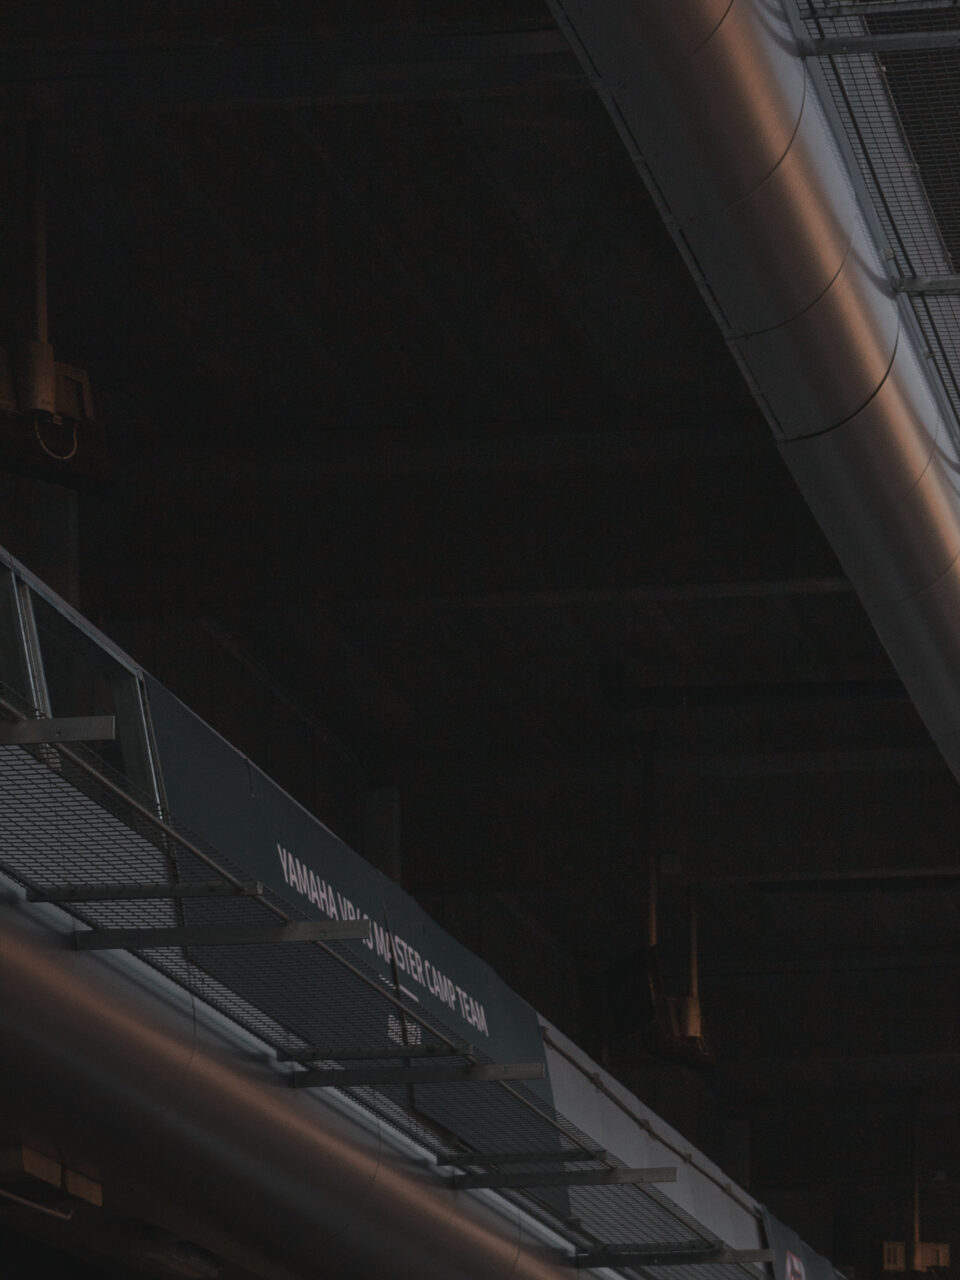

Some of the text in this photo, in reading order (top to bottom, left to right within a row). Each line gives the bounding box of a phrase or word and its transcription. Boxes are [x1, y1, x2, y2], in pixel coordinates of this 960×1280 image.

[276, 843, 339, 921] YAMAHA
[424, 959, 456, 1011] CAMP
[455, 985, 489, 1038] TEAM
